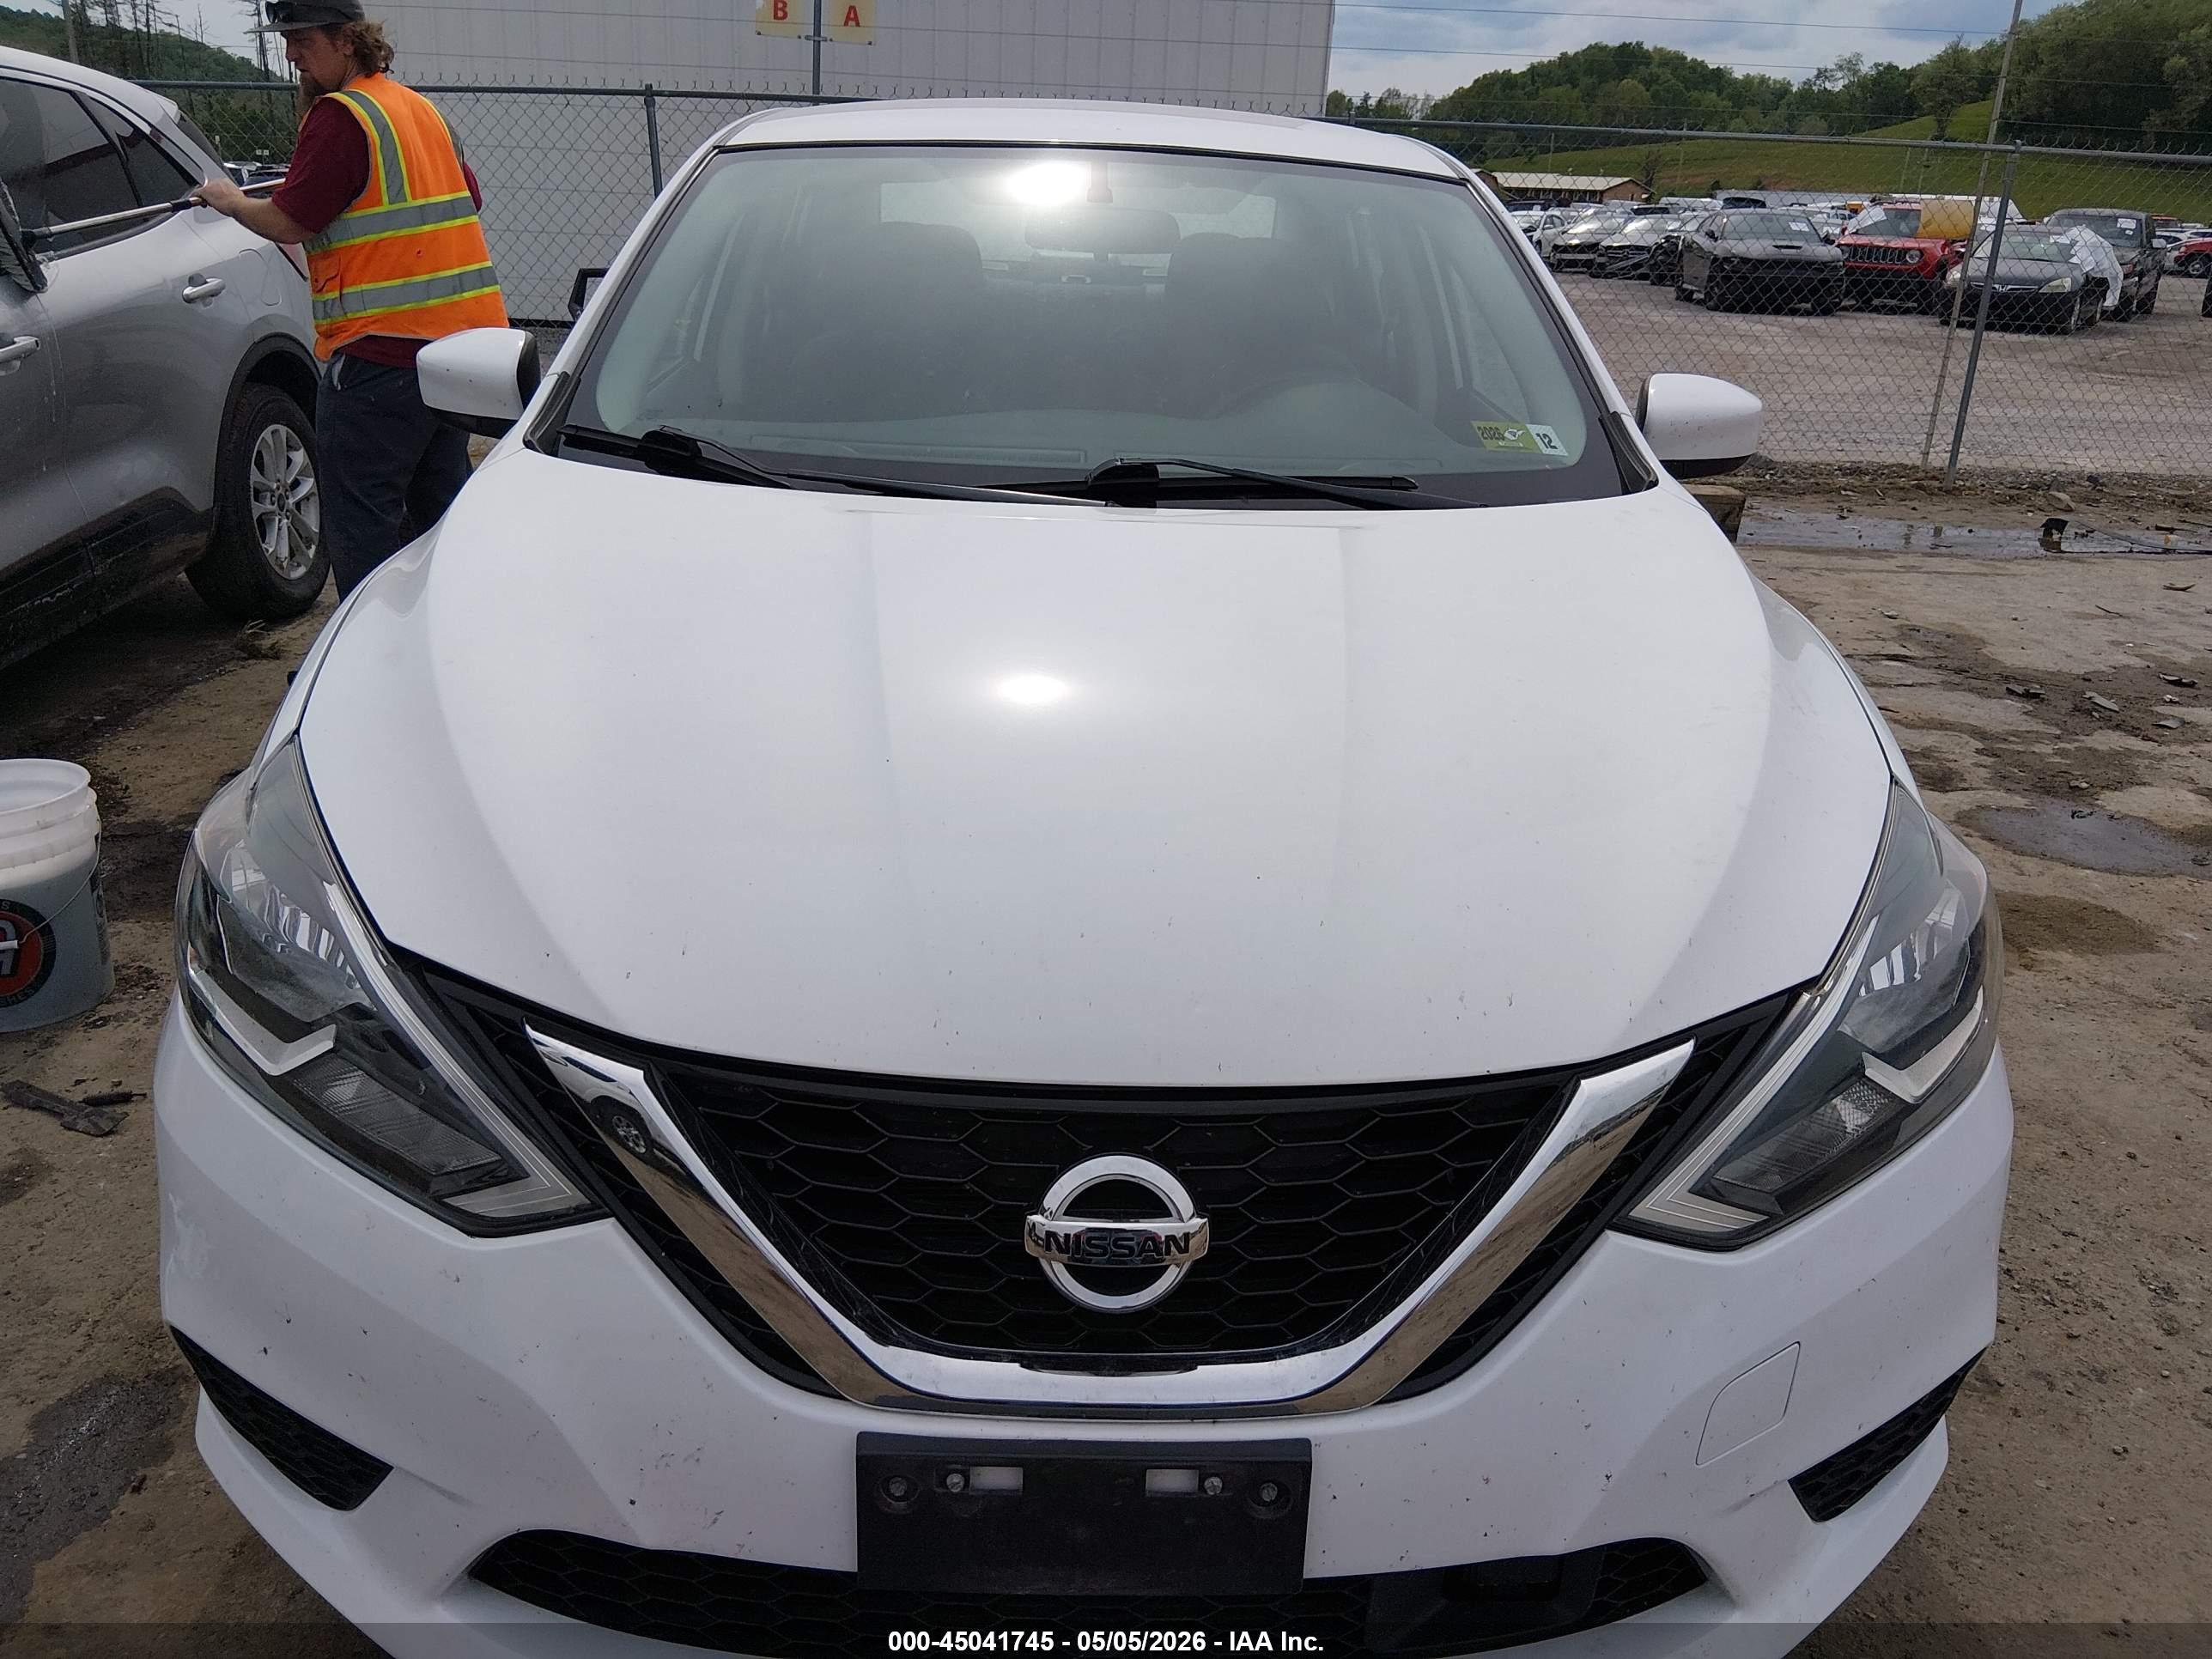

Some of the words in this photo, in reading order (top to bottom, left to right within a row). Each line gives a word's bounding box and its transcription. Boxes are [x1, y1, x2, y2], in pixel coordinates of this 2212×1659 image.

[773, 0, 788, 21] B
[843, 5, 860, 27] A
[1535, 433, 1559, 450] 12
[1044, 1231, 1190, 1258] NISSAN
